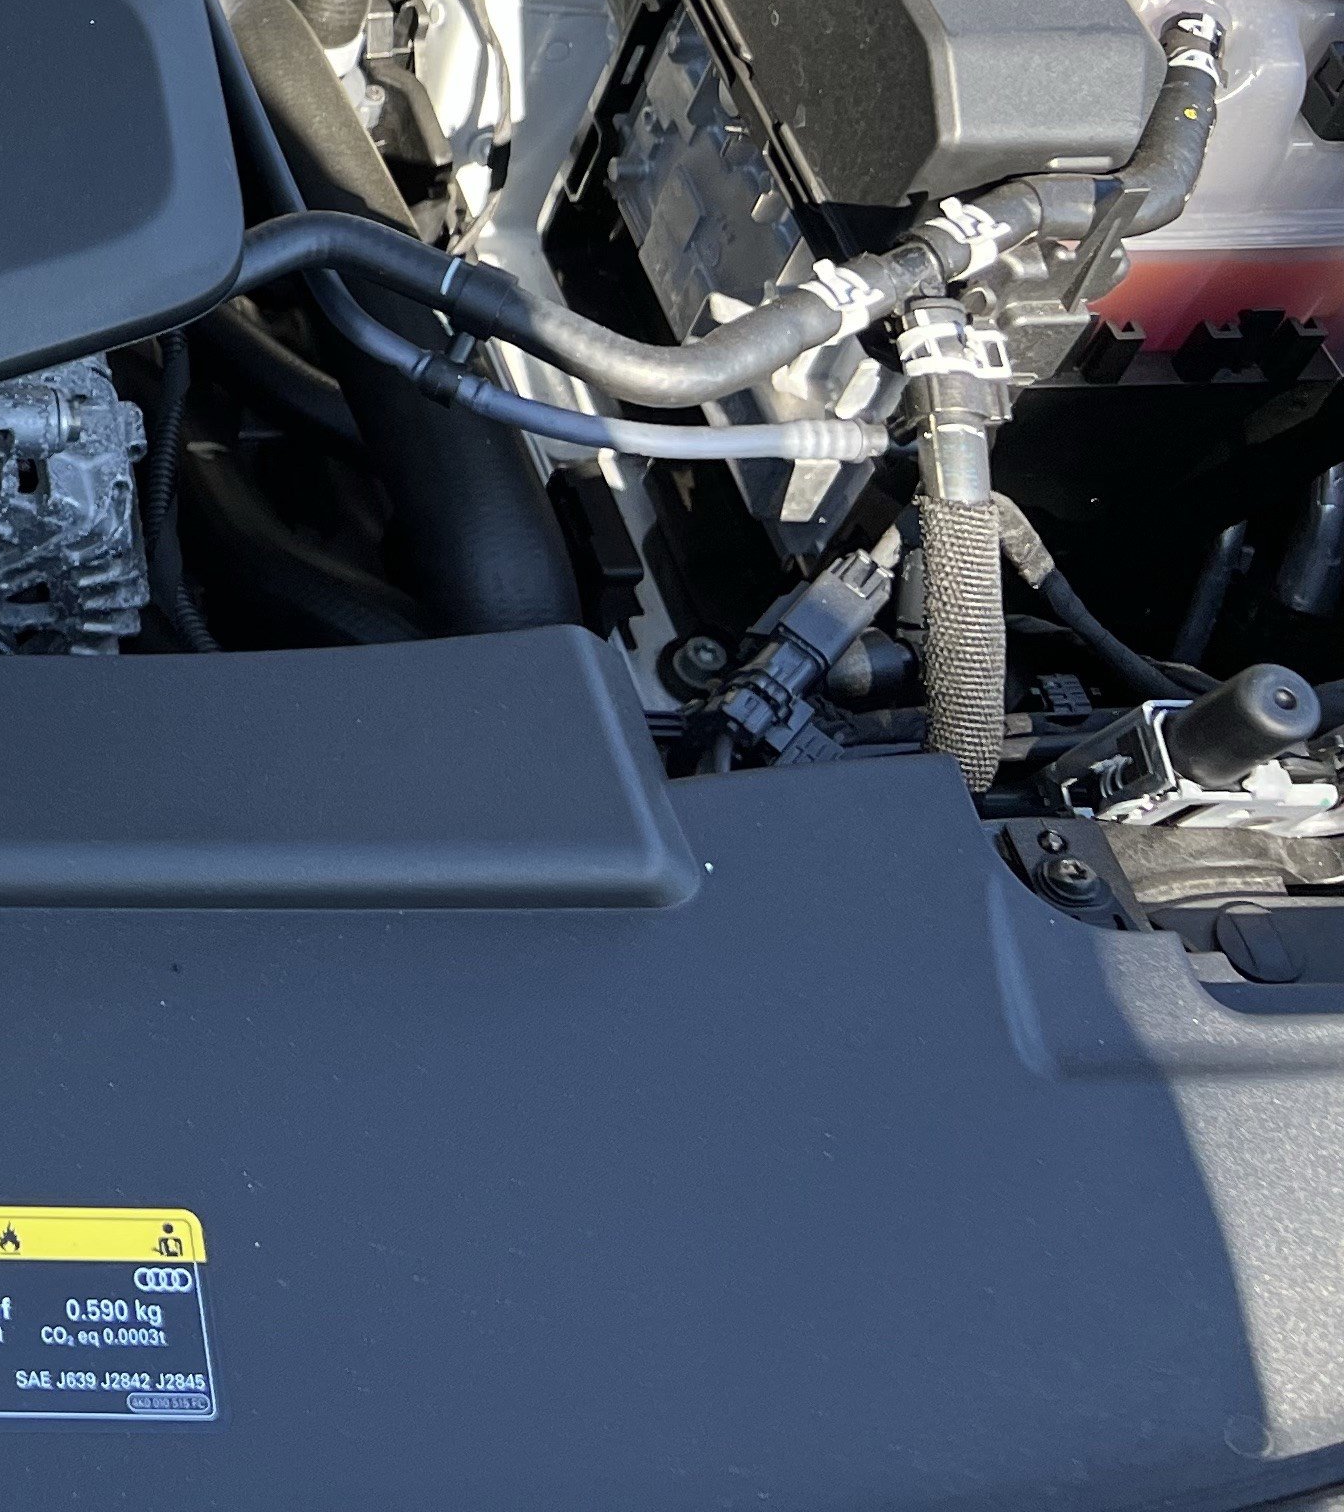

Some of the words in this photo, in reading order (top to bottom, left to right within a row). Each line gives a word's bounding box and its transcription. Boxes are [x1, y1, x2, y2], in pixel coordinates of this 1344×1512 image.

[65, 1298, 129, 1322] 0.590
[135, 1299, 162, 1325] kg
[78, 1329, 99, 1348] eq
[104, 1327, 167, 1346] 0.0003t
[16, 1370, 51, 1389] SAE
[56, 1371, 96, 1389] J639
[101, 1371, 150, 1390] J2842
[155, 1371, 205, 1390] J2845
